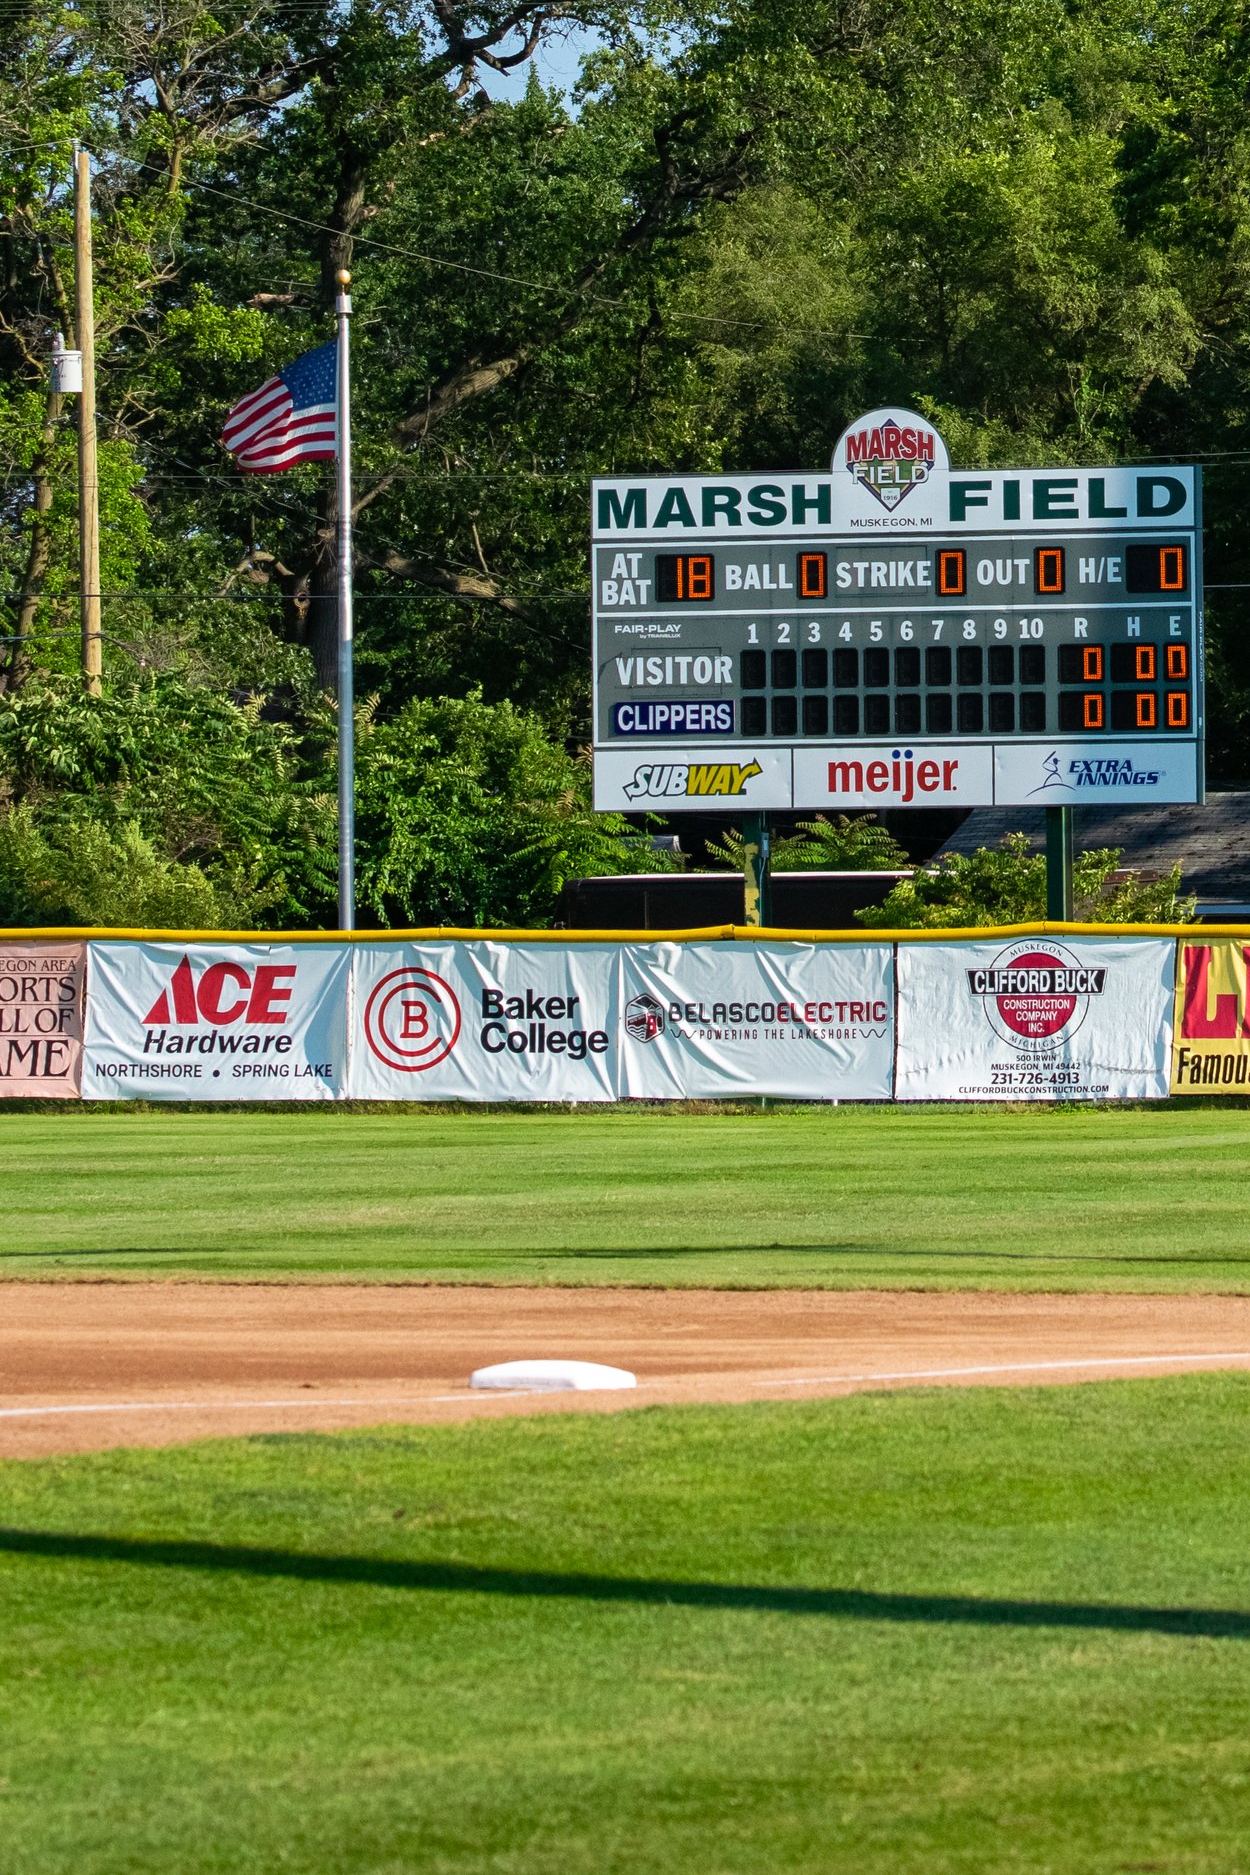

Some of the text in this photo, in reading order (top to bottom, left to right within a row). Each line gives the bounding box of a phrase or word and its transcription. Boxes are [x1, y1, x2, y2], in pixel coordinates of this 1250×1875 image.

[846, 427, 935, 462] MARSH
[852, 465, 930, 484] FIELD
[598, 476, 1188, 529] MARSH FIELD
[850, 517, 933, 527] MUSKEGON, MI
[611, 552, 643, 579] AT
[676, 547, 1183, 599] 18 BALL 0 STRIKE 0 OUT 0 H/E 0
[601, 579, 652, 606] BAT
[614, 624, 682, 634] FAIR-PLAY
[748, 615, 1182, 643] 1 2 3 4 5 6 7 8 9 10 R H E
[616, 645, 1186, 685] VISITOR 0 0 0
[618, 693, 1186, 731] CLIPPERS 0 0 0
[1069, 759, 1133, 774] EXTRA
[623, 757, 763, 802] SUBWAY
[1076, 772, 1161, 786] INNINGS
[1009, 943, 1064, 958] MUSKEGON
[41, 959, 77, 972] AREA
[0, 976, 77, 1002] ORTS
[141, 953, 298, 1026] ACE
[974, 970, 1099, 993] CLIFFORD BUCK
[481, 988, 580, 1020] Baker
[668, 1000, 888, 1024] BELASCOELECTRIC
[1003, 999, 1071, 1010] CONSTRUCTION
[34, 1007, 75, 1033] OF
[1015, 1011, 1058, 1021] COMPANY
[1028, 1022, 1045, 1033] INC.
[143, 1029, 293, 1055] Hardware
[480, 1021, 610, 1061] College
[699, 1027, 858, 1041] POWERING THE LAKESHORE
[1008, 1035, 1064, 1048] MICHIGAN
[0, 1039, 72, 1077] ME
[990, 1062, 1081, 1072] MUSKEGON, MI 49442
[1016, 1054, 1057, 1062] 500 IRWIN
[95, 1063, 333, 1078] NORTHSHORE SPRING LAKE
[991, 1072, 1080, 1085] 231-726-4913
[958, 1085, 1109, 1094] CLIFFORDBUCKCONSTRUCTION.COM
